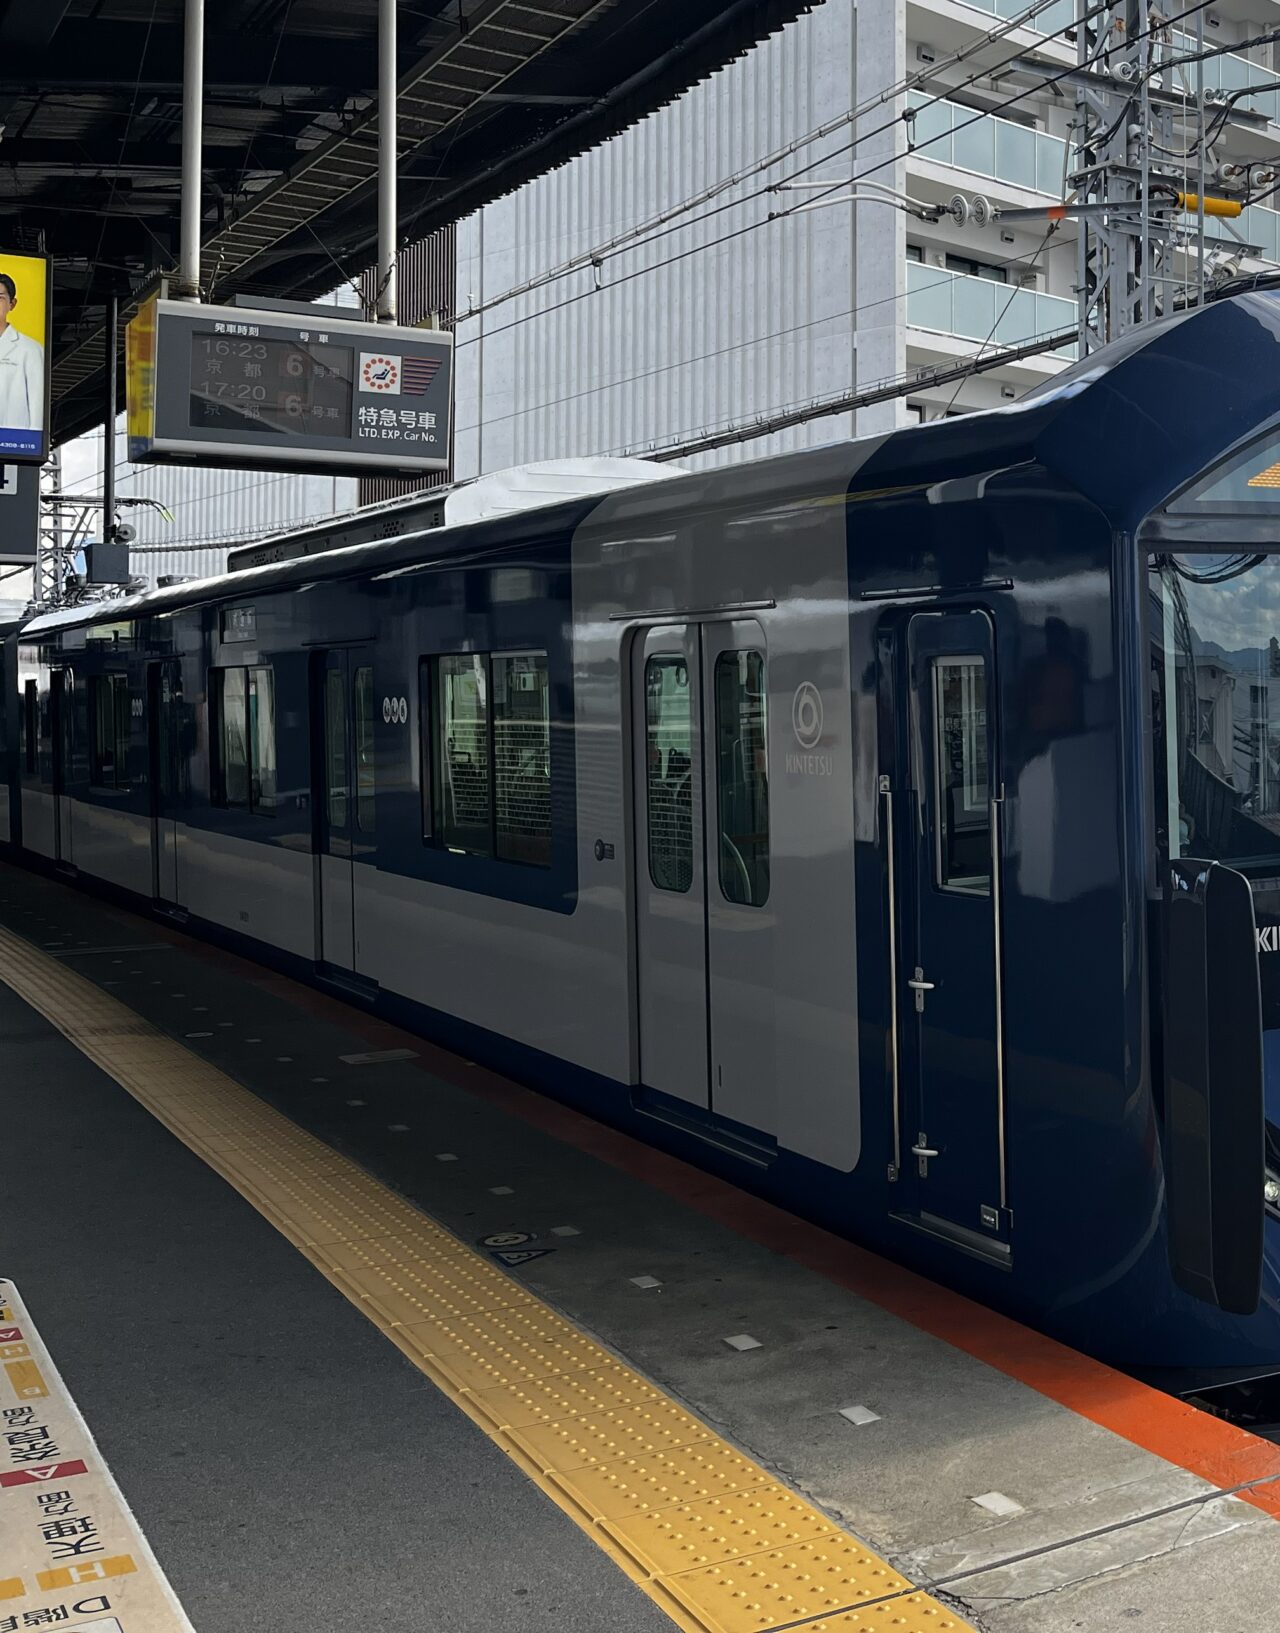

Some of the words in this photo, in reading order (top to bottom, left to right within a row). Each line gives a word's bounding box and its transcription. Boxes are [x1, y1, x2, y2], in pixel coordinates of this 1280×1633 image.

[214, 323, 259, 337] 発車時刻
[202, 339, 267, 359] 16:23
[286, 354, 303, 376] 6
[200, 381, 266, 400] 17:20
[285, 395, 303, 417] 6
[358, 406, 437, 430] 特急号車
[403, 431, 420, 441] Car
[421, 432, 438, 442] No.
[785, 751, 833, 776] KINTETSU
[3, 1406, 61, 1464] 奈良方面
[25, 1465, 59, 1480] A
[37, 1491, 105, 1560] 天理方面
[67, 1562, 106, 1583] H
